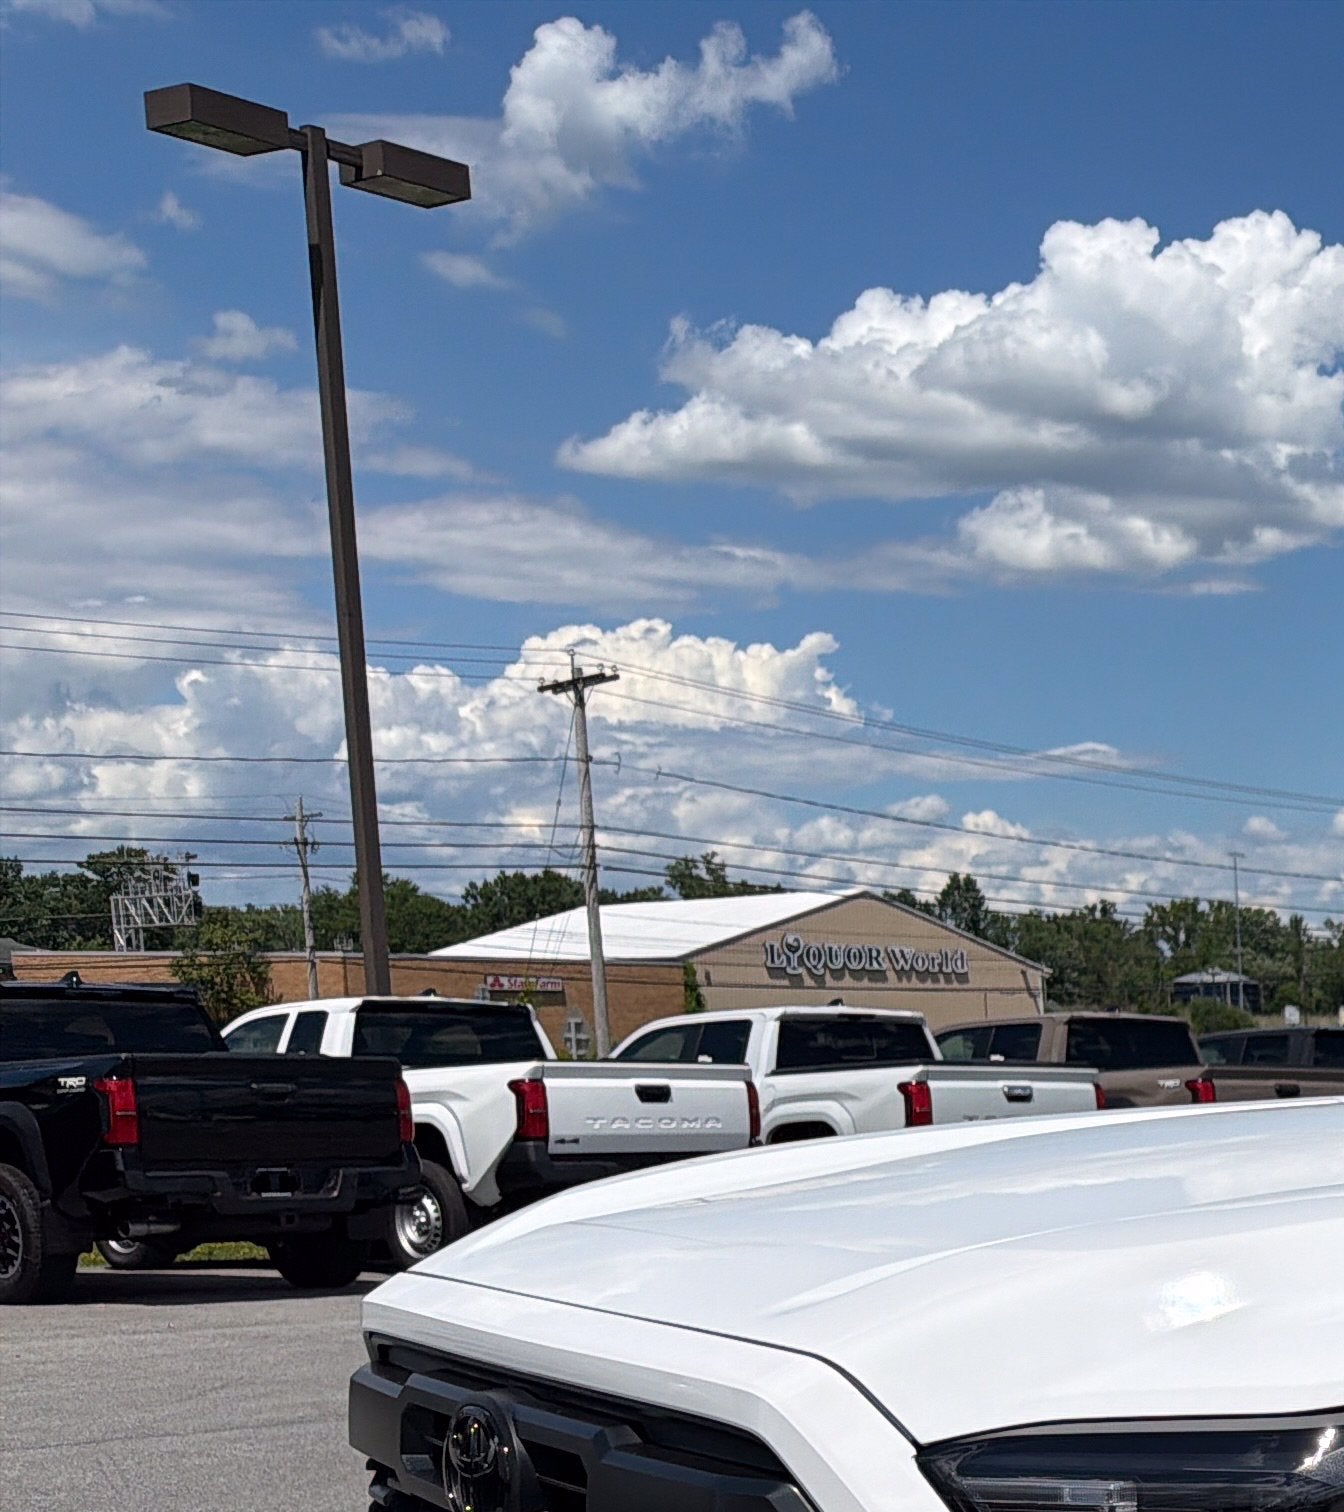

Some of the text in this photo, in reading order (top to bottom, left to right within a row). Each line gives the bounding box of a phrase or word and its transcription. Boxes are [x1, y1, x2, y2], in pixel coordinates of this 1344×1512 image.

[887, 946, 969, 974] World
[507, 976, 534, 989] Sta
[57, 1076, 87, 1088] TRD
[584, 1116, 723, 1130] TACOMA
